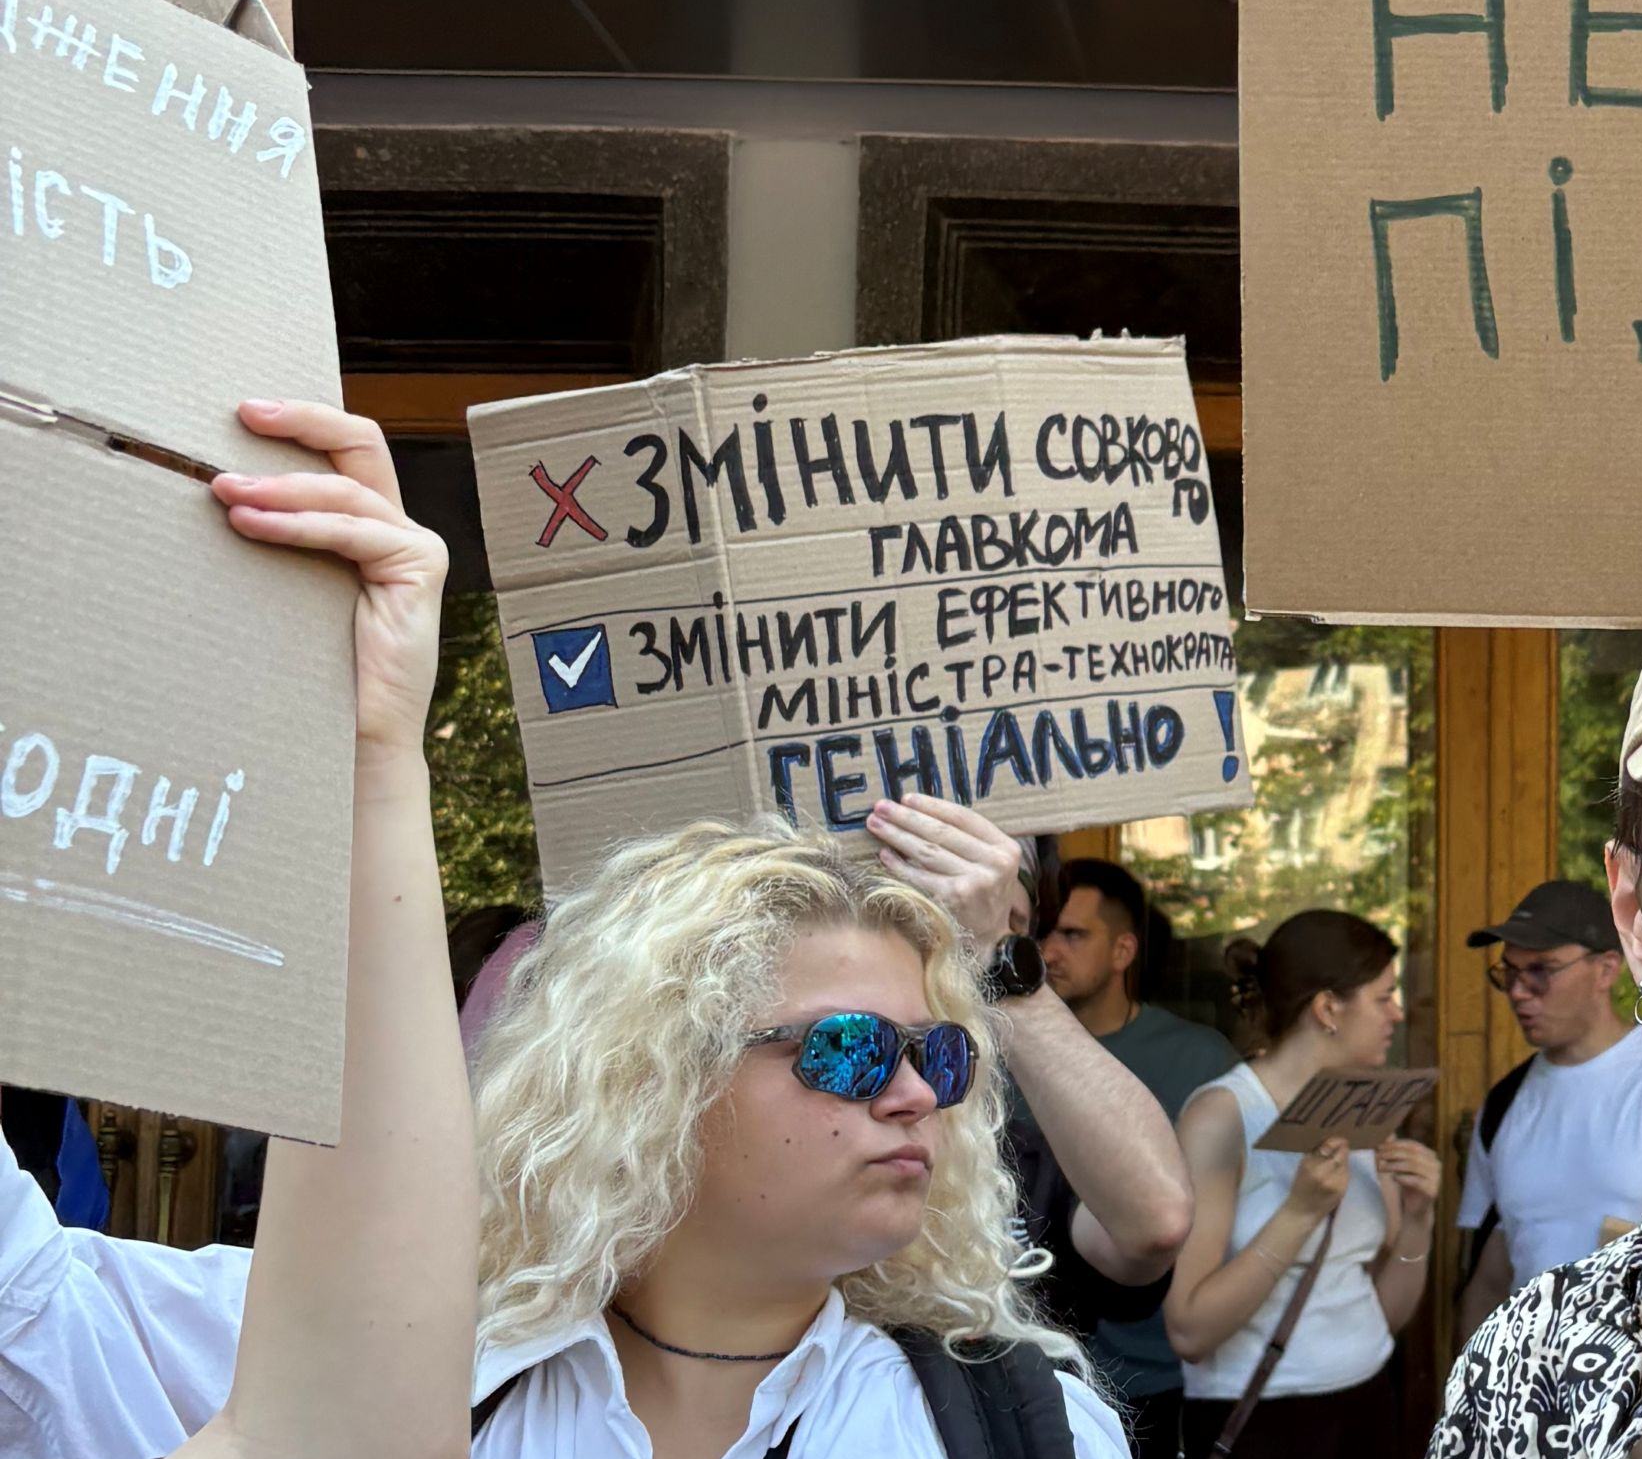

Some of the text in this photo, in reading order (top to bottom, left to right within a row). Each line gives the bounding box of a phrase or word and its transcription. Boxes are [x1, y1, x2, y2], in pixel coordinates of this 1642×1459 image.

[622, 393, 1202, 549] ЗМІНИТИ СОВКОВО
[867, 501, 1140, 579] ГЛАВКОМА
[628, 577, 1224, 696] ЗМІНИТИ ЕФЕКТИВНОГО
[0, 718, 246, 875] ОДНІ
